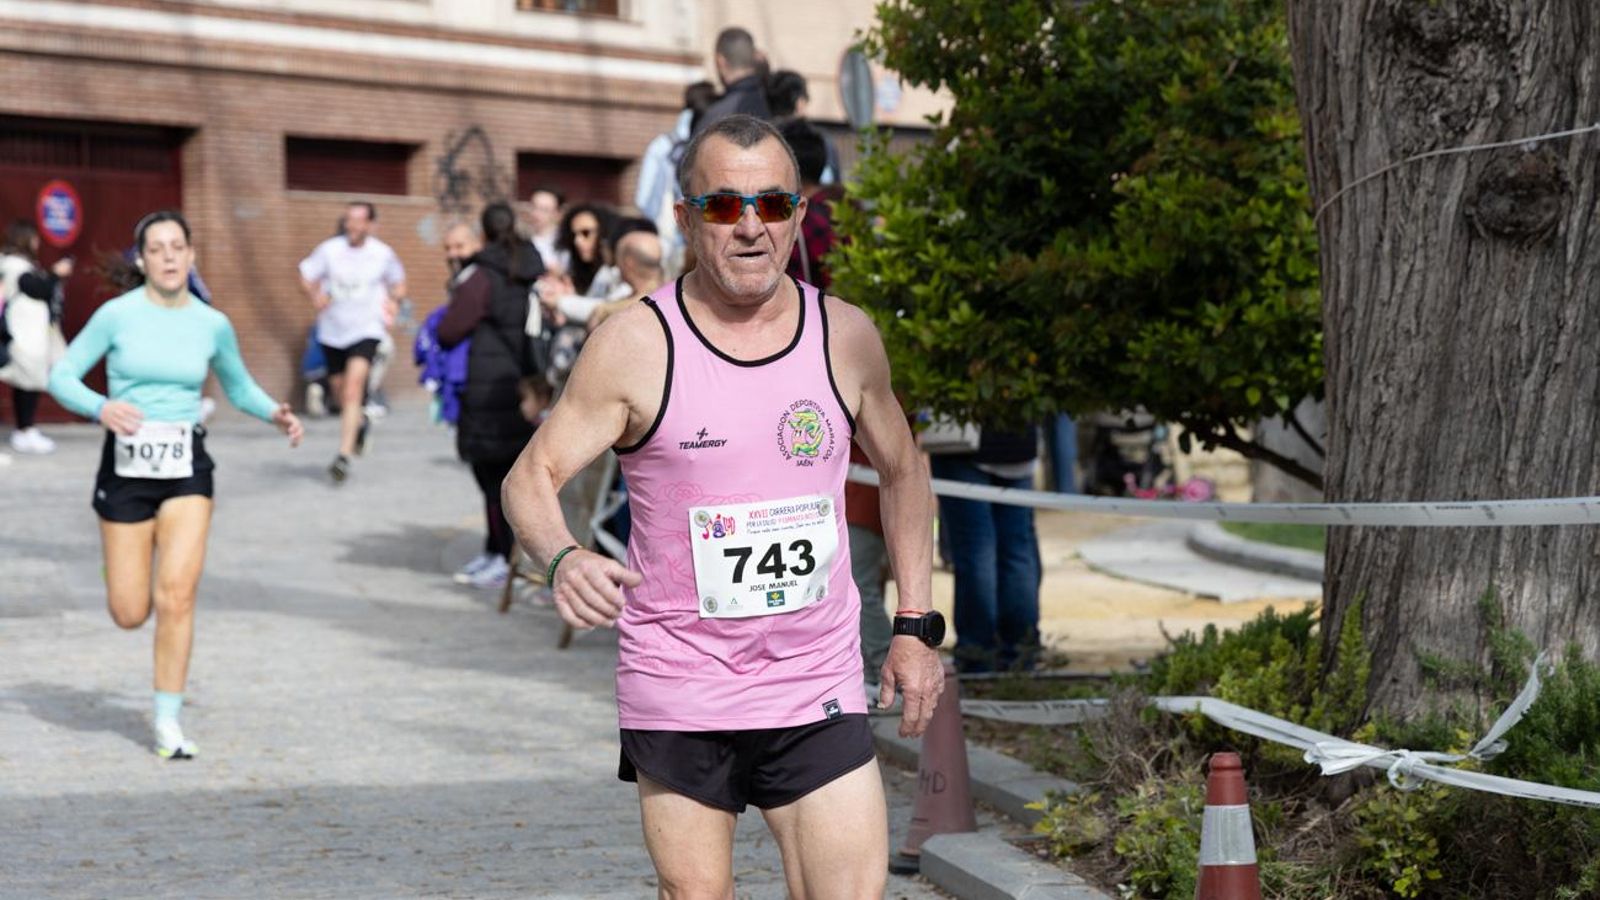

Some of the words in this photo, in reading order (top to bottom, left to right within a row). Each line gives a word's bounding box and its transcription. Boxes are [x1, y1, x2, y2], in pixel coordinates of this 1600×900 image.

[679, 439, 727, 450] TEAMERGY
[124, 442, 184, 460] 1078
[769, 504, 795, 516] CARRERA
[723, 539, 816, 584] 743
[749, 584, 766, 592] JOSE
[768, 580, 798, 590] MANUEL
